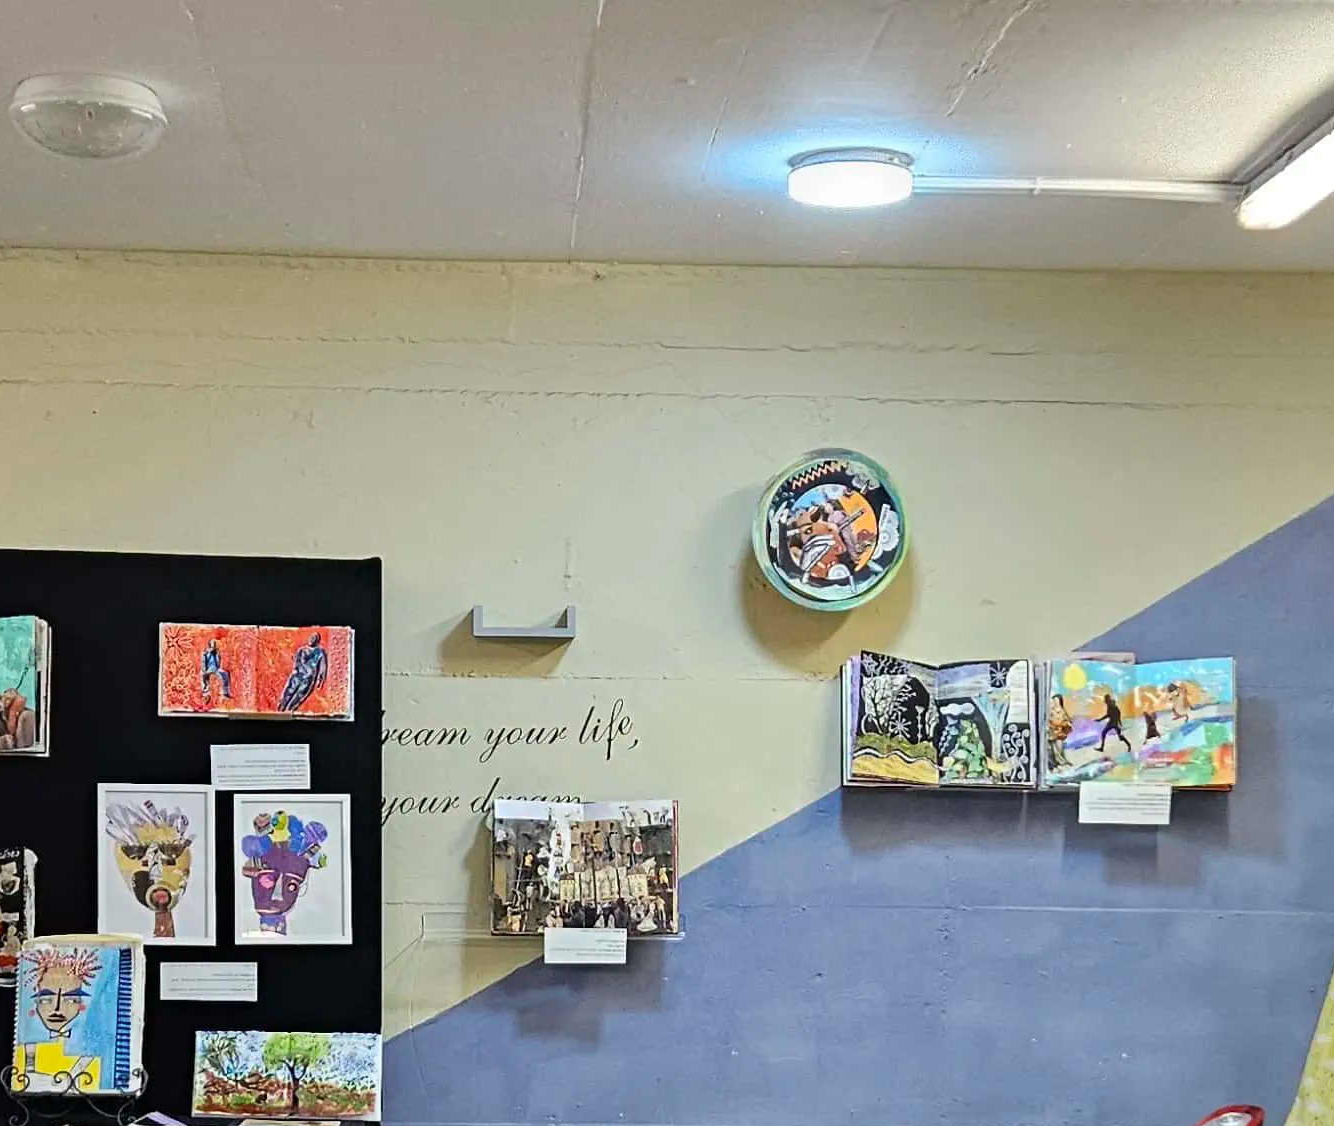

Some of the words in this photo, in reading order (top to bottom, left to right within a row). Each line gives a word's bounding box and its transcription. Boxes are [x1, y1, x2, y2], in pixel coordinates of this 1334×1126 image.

[381, 709, 472, 746] ream
[479, 727, 568, 764] your
[579, 698, 640, 761] life,
[381, 796, 460, 826] your
